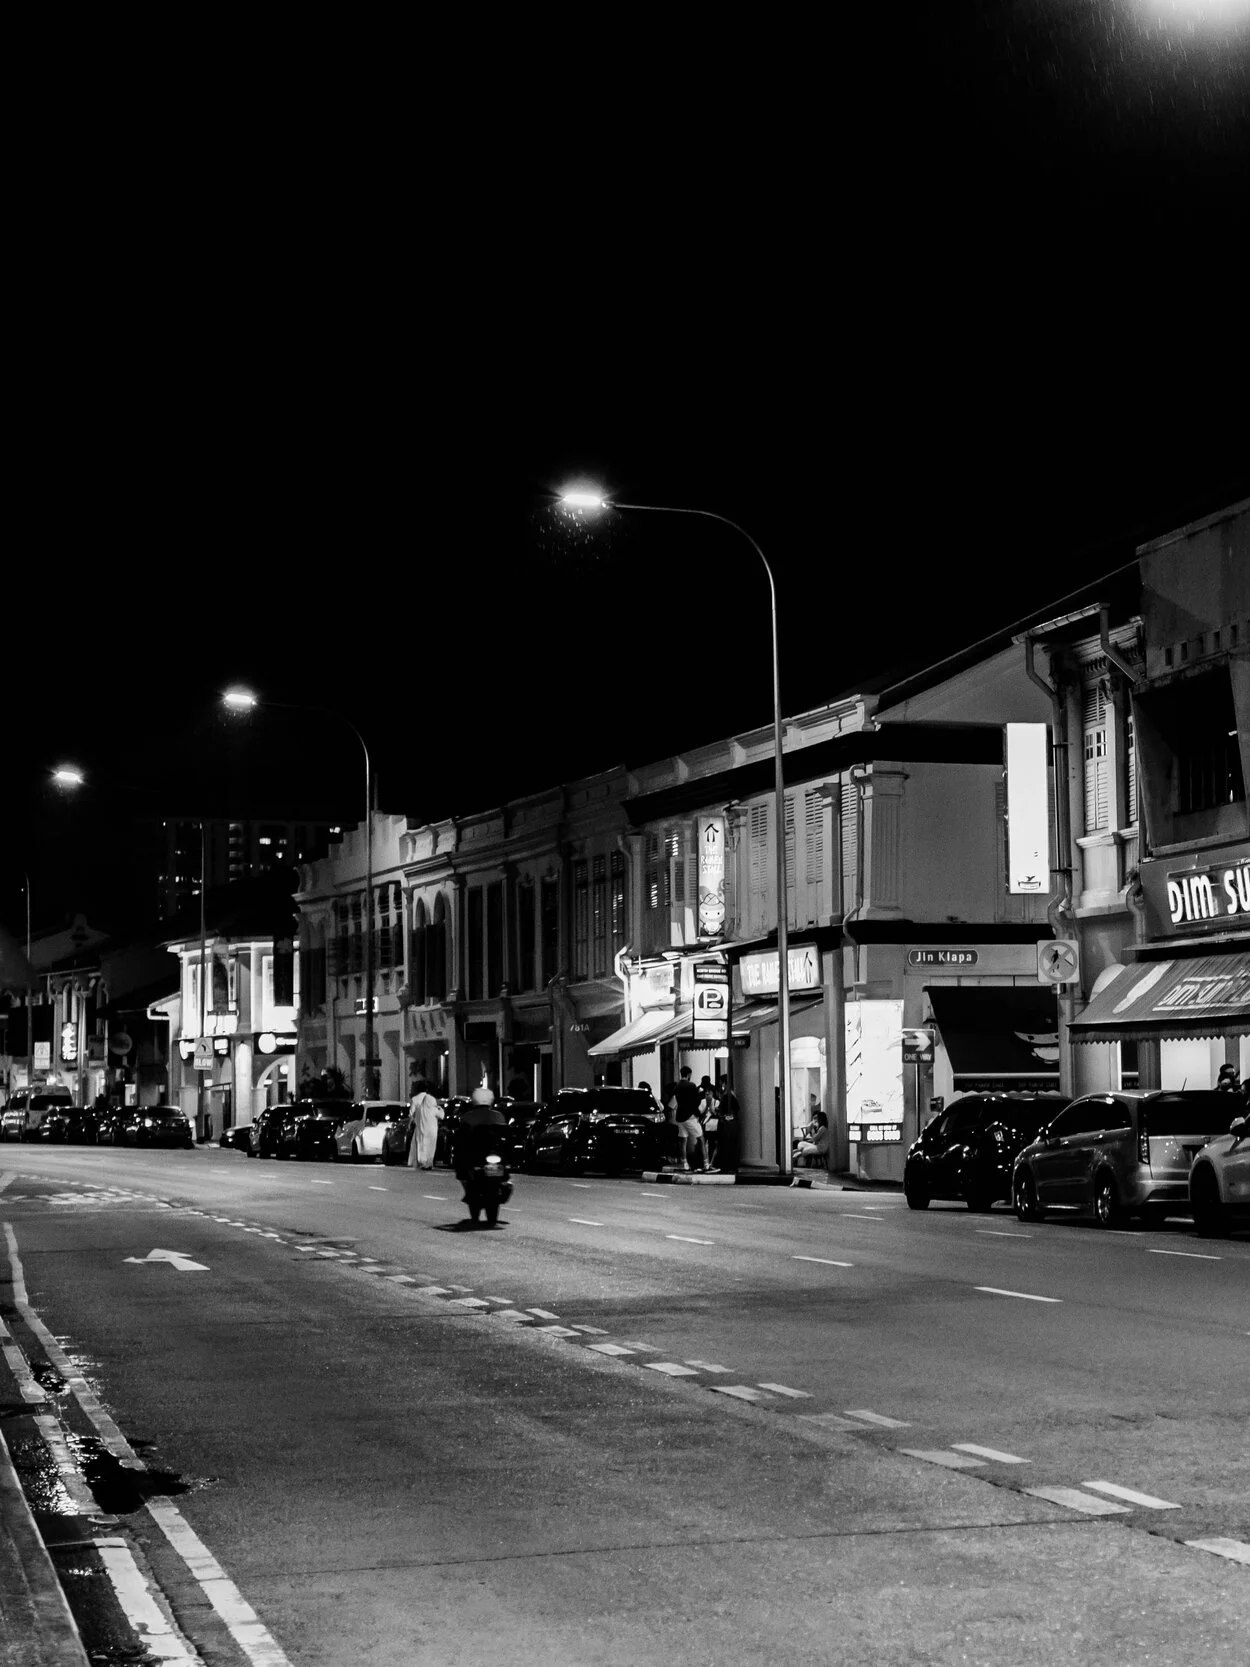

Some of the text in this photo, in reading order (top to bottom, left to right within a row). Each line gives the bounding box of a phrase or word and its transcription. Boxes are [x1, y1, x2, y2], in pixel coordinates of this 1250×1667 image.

[1167, 875, 1215, 923] DIM
[916, 951, 972, 964] Jln Klapa
[761, 958, 780, 985] RAME
[904, 1053, 932, 1061] ONE WAY
